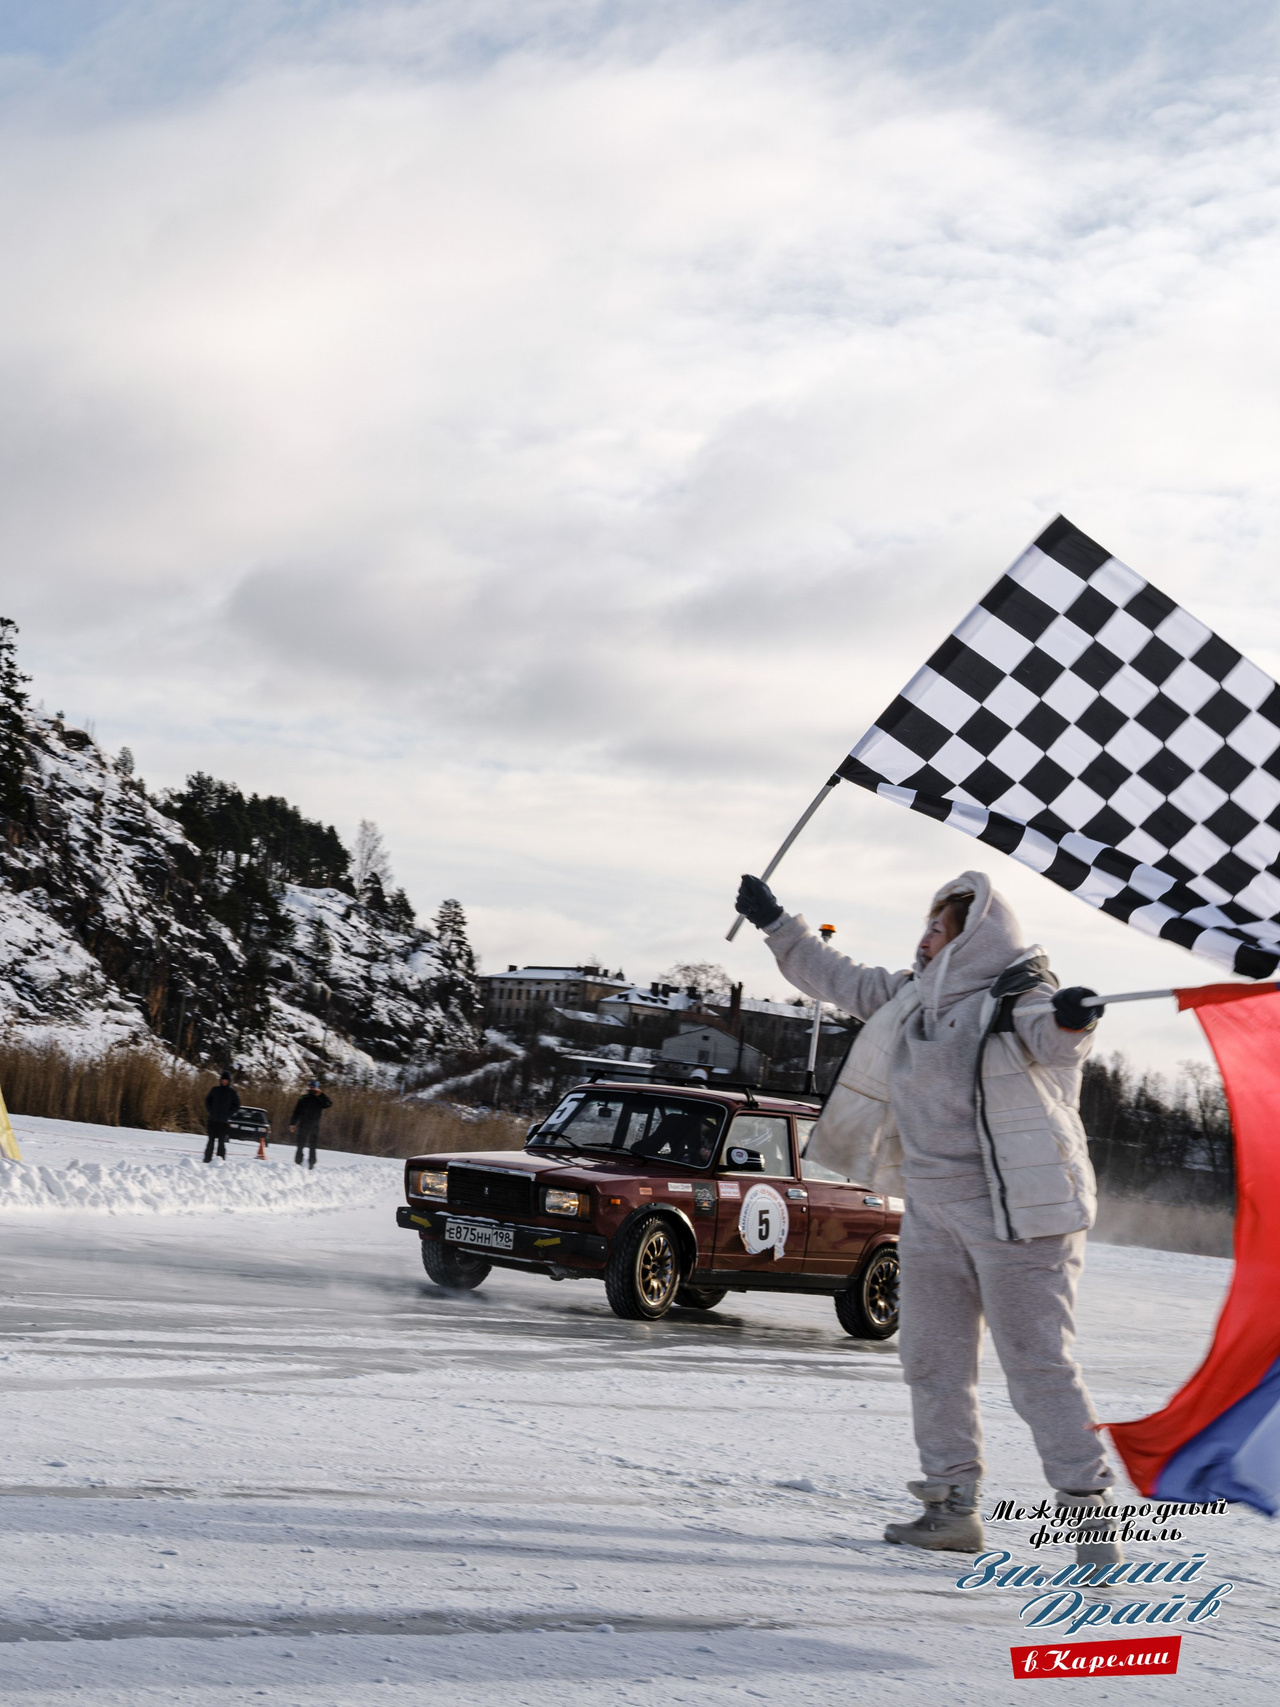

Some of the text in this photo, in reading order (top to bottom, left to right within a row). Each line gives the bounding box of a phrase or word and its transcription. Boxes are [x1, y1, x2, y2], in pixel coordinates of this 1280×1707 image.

[546, 1093, 587, 1125] 5
[493, 1230, 510, 1243] 198
[758, 1209, 770, 1241] 5
